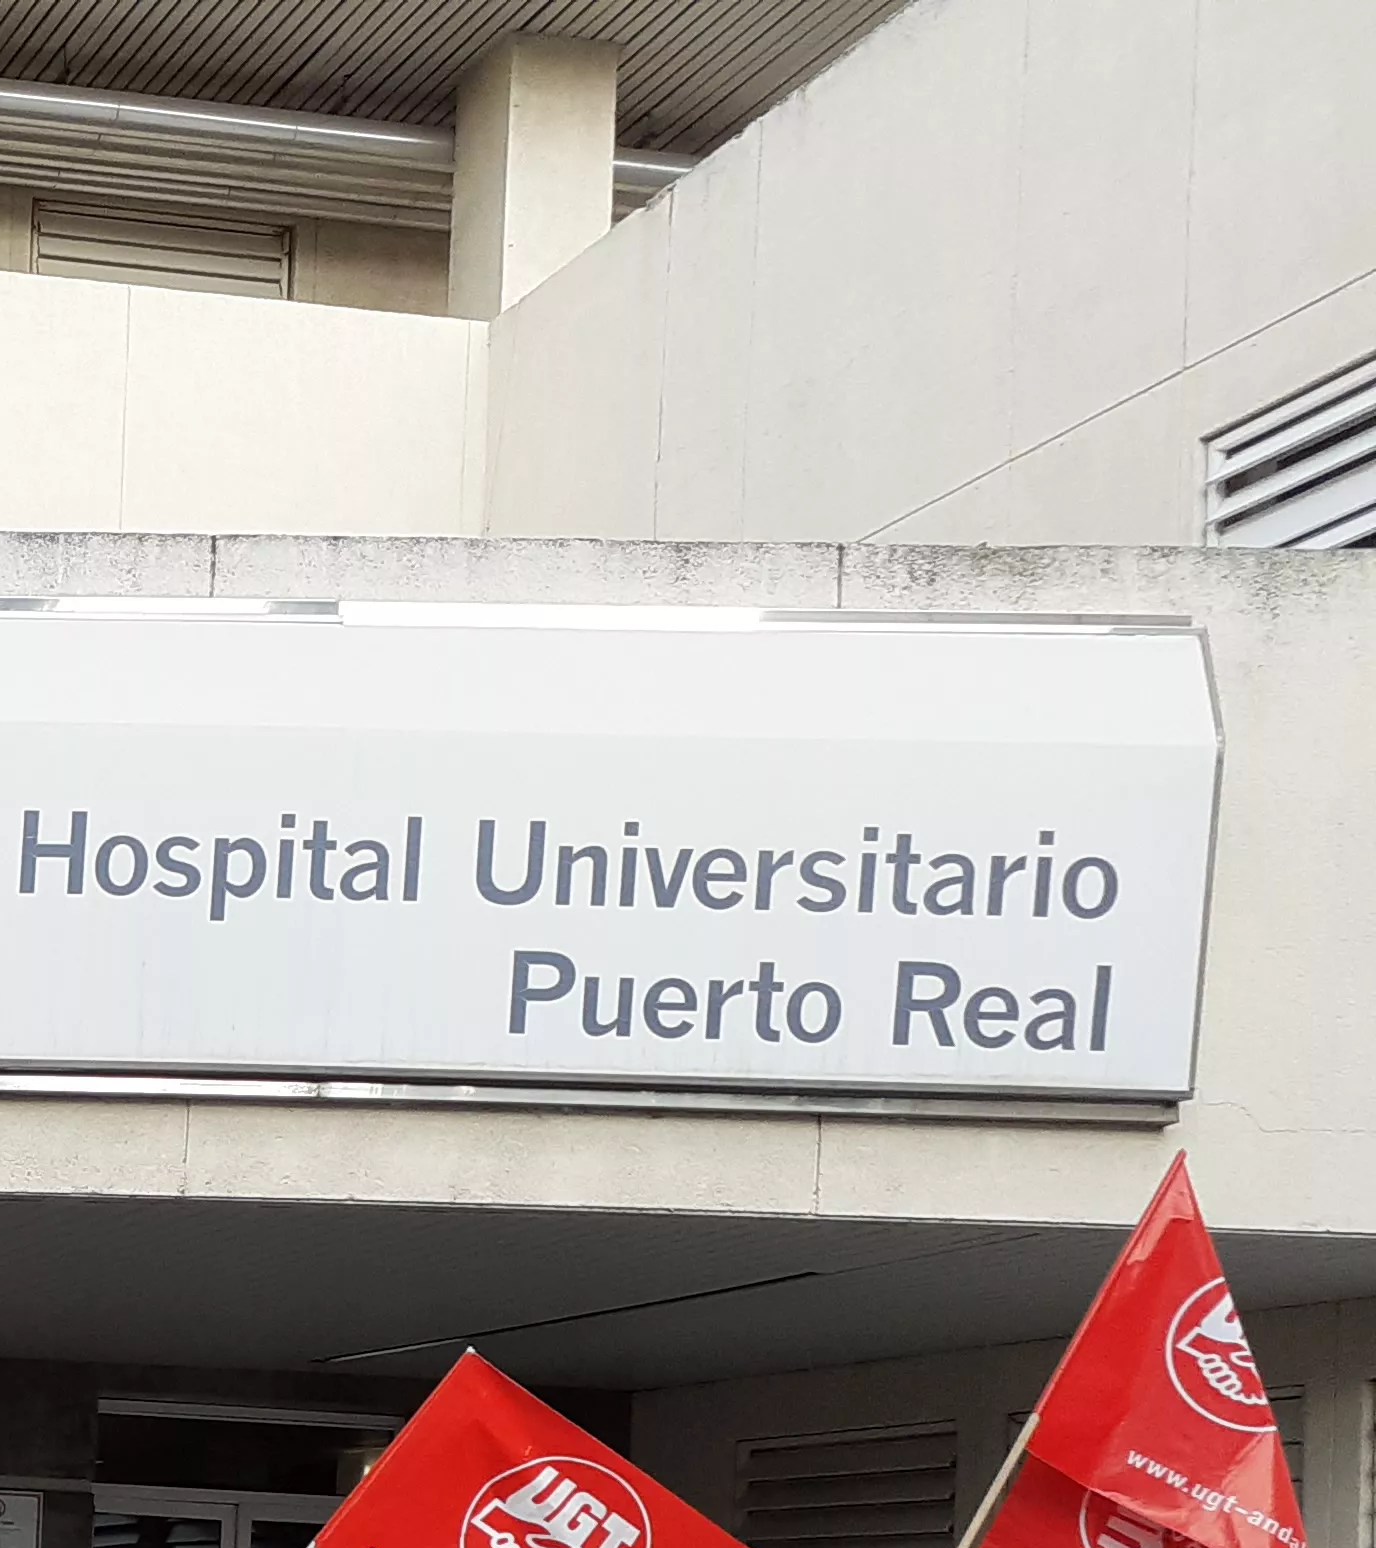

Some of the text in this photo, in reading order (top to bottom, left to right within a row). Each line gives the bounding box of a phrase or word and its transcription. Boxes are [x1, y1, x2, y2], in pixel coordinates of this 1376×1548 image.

[18, 810, 1118, 921] Hospital Universitario
[508, 950, 1112, 1051] Puerto Real
